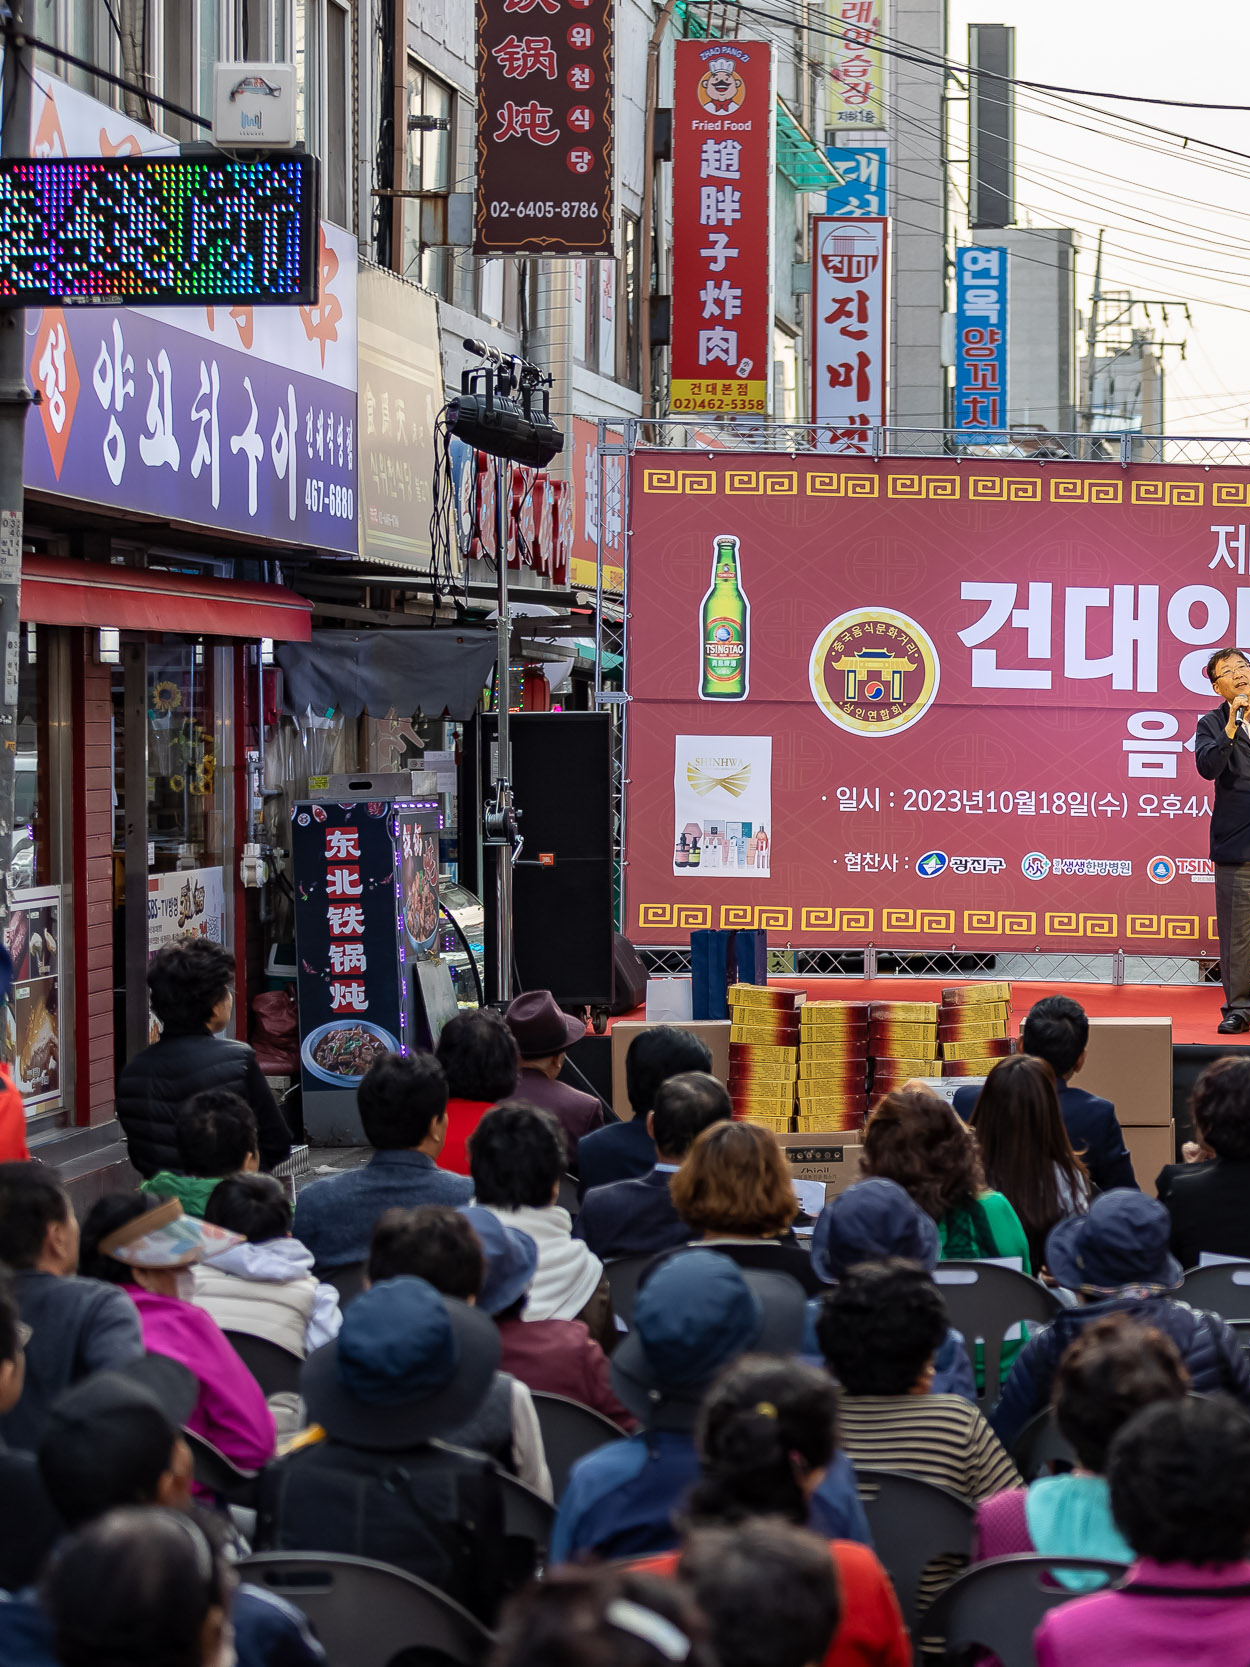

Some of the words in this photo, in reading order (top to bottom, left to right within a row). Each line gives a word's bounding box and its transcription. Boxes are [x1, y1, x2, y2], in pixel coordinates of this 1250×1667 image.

[492, 0, 560, 145] 锅炖
[692, 120, 721, 131] Fried
[723, 120, 752, 131] Food
[490, 202, 599, 219] 02-6405-8786
[673, 398, 765, 412] 02)462-5358
[305, 478, 354, 521] 467-6880
[831, 622, 918, 655] 중국음식문화거리
[705, 644, 744, 654] TSINGTAO
[842, 702, 903, 722] 상인연합회
[836, 786, 881, 812] 일시
[902, 788, 1129, 820] 2023년10월18일(수)
[844, 852, 899, 874] 협찬사
[950, 857, 1005, 874] 광진구
[1177, 859, 1215, 874] TSIN
[325, 829, 369, 1011] 东北铁锅炖
